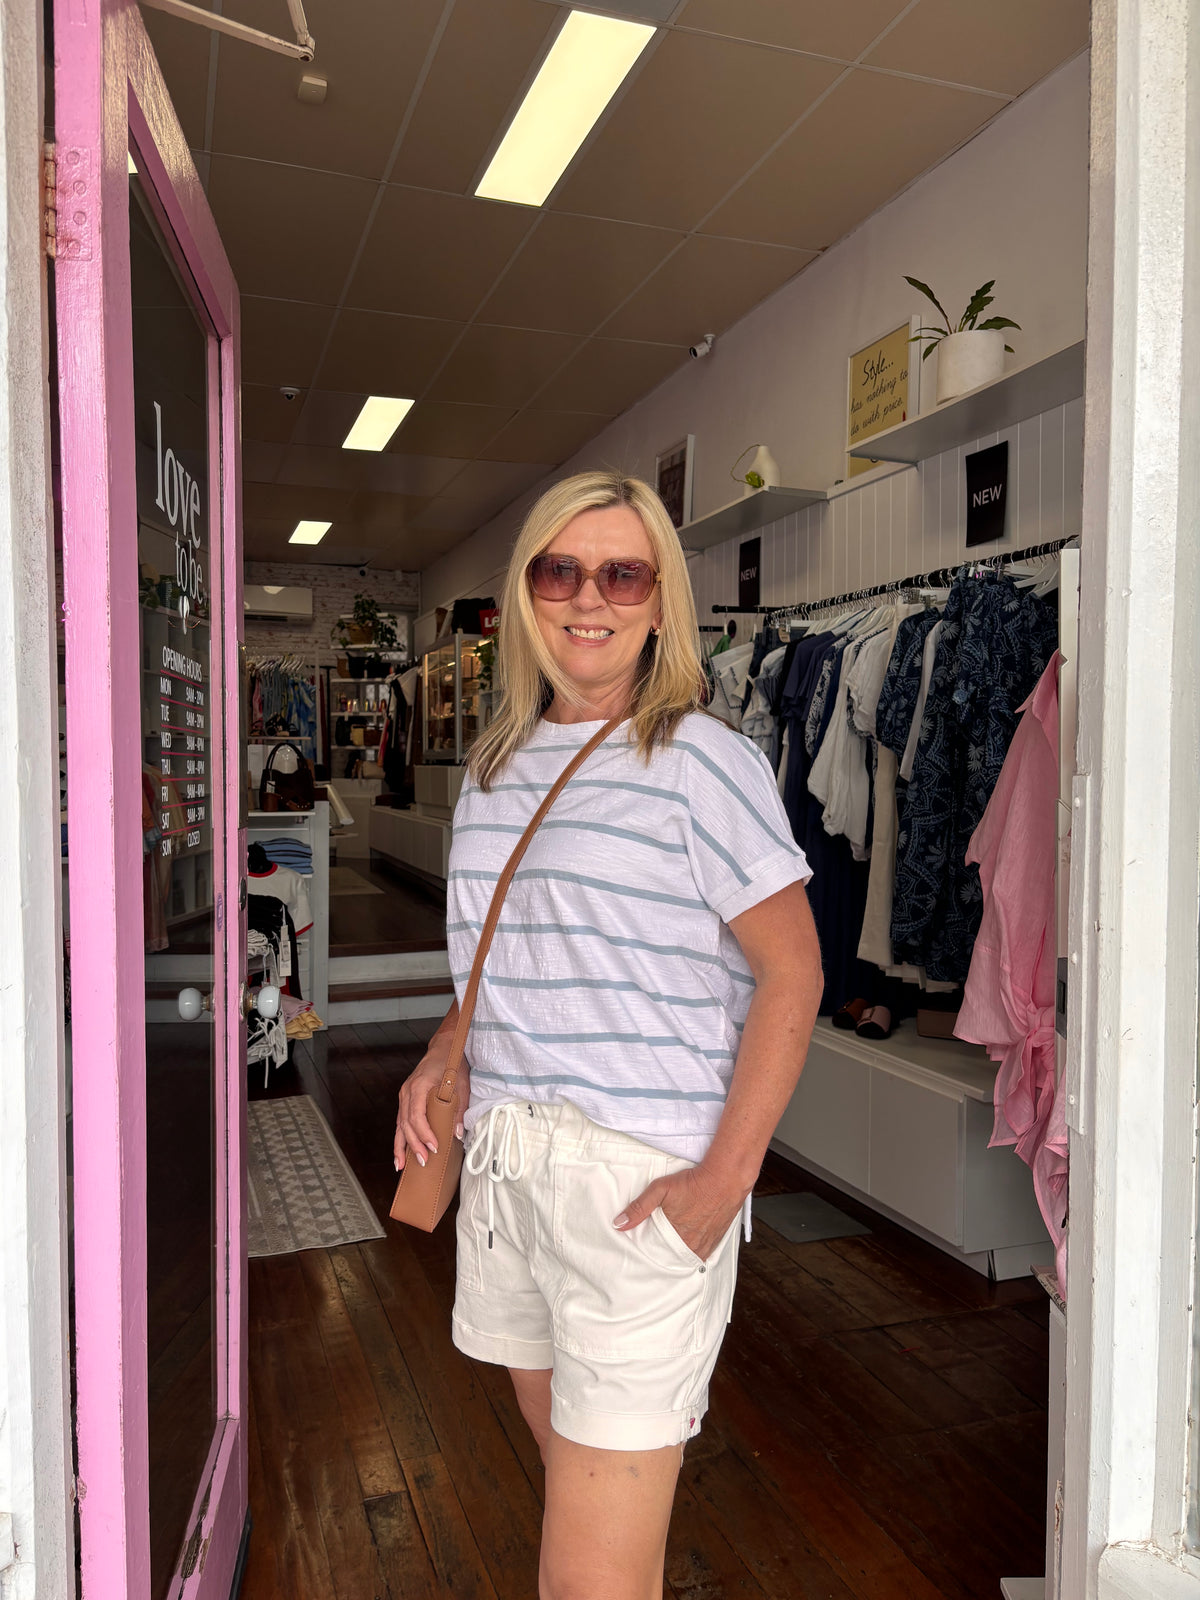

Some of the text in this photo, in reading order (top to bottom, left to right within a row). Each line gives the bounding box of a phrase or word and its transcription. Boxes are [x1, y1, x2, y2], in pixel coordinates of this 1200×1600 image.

[851, 368, 909, 414] has nothing to
[850, 421, 860, 437] do
[862, 404, 880, 429] with
[154, 401, 200, 549] love
[972, 484, 1003, 508] NEW
[175, 531, 203, 604] to be
[740, 566, 758, 582] NEW
[162, 645, 202, 682] OPENING HOURS
[160, 677, 172, 696] MON
[160, 704, 170, 722] TUE
[160, 732, 172, 749] WED
[161, 759, 171, 775] THU
[161, 786, 169, 802] FRI
[161, 812, 170, 830] SAT
[162, 830, 201, 857] SUN CLOSED
